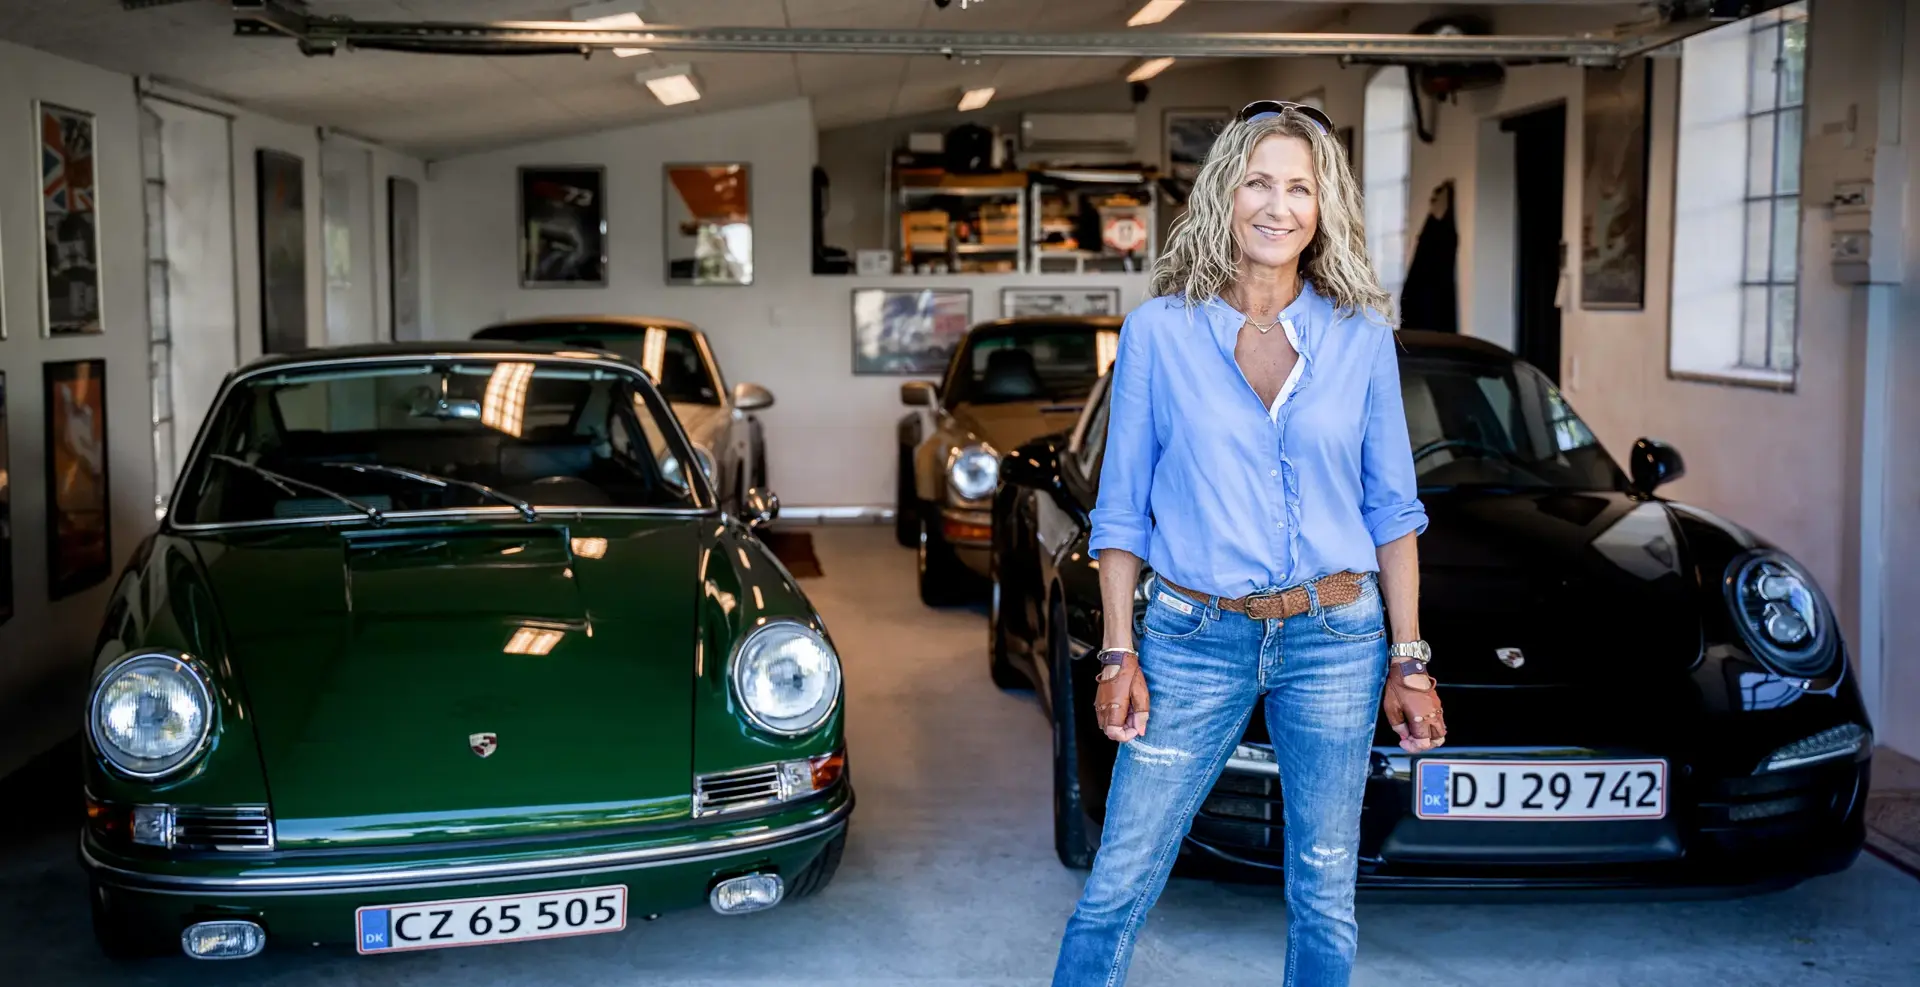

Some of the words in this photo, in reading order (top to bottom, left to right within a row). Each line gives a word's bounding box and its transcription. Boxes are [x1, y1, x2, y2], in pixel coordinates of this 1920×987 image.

[1424, 794, 1442, 807] DK
[1451, 772, 1506, 808] DJ
[1521, 772, 1571, 811] 29
[1584, 771, 1657, 808] 742
[395, 910, 454, 941] CZ
[469, 905, 521, 936] 65
[537, 895, 616, 930] 505
[366, 933, 384, 944] DK
